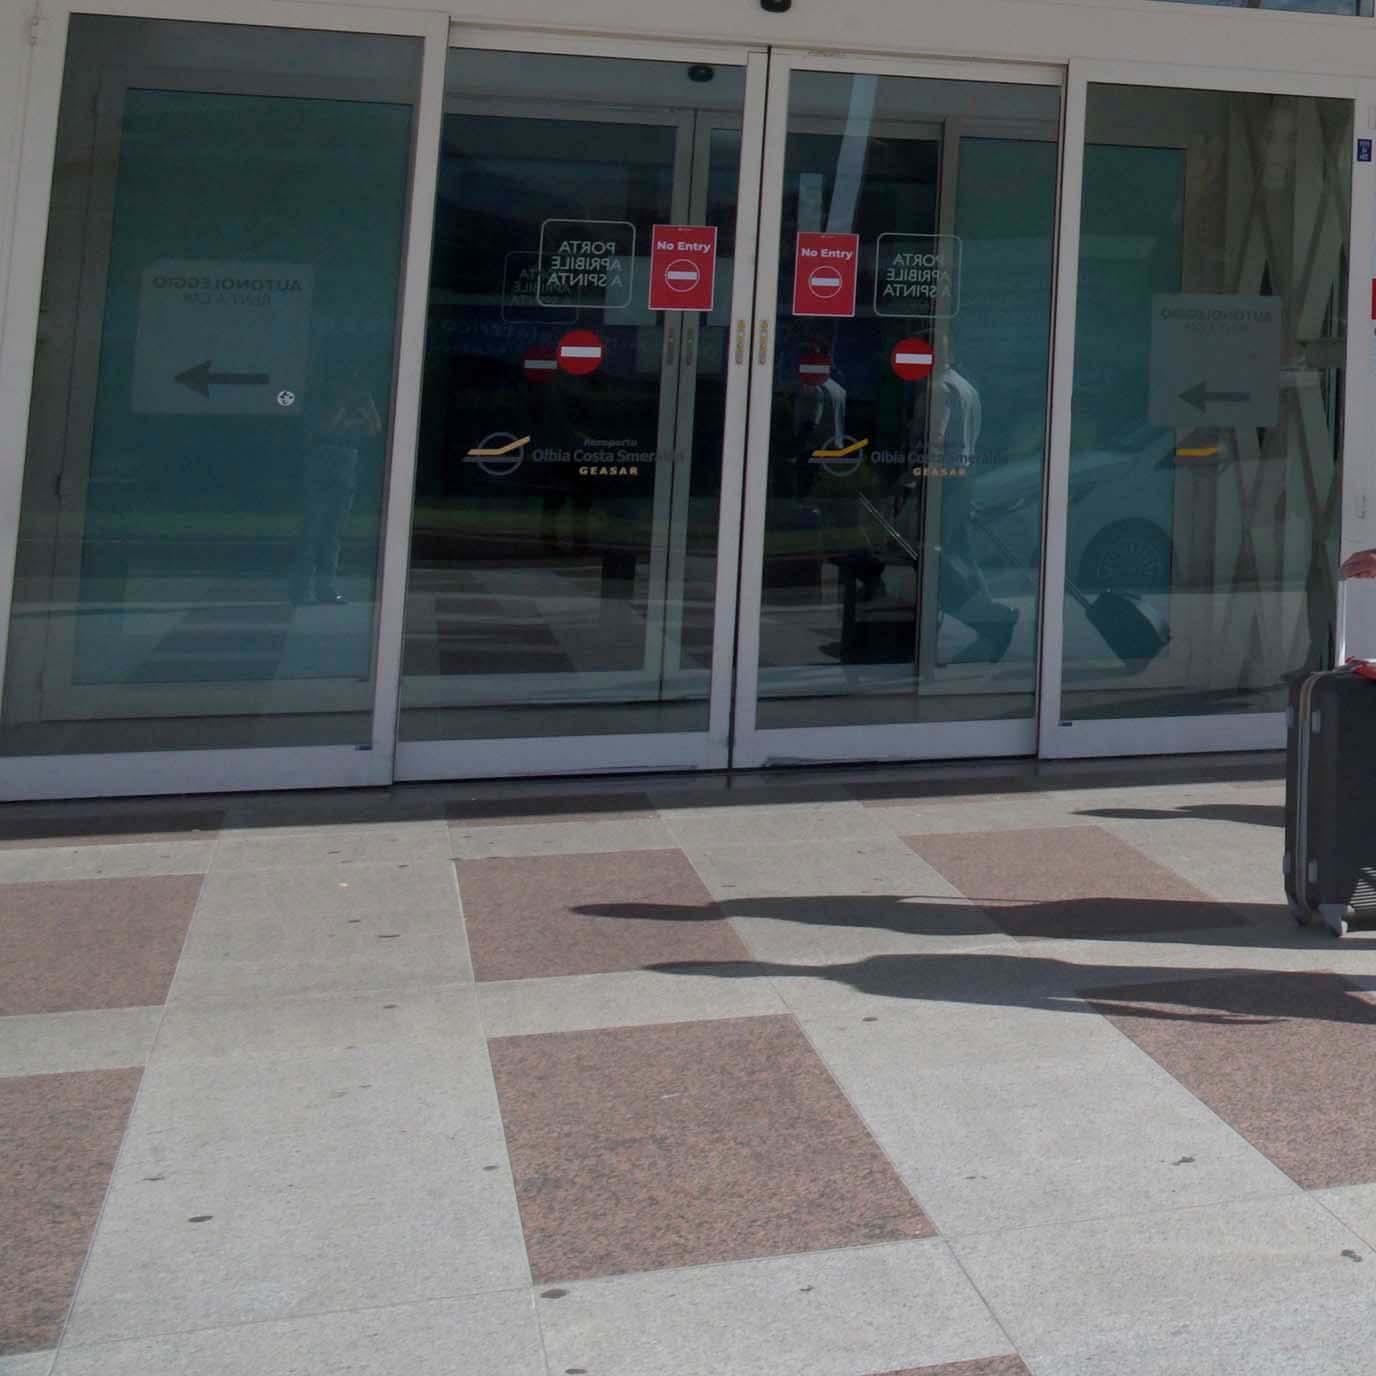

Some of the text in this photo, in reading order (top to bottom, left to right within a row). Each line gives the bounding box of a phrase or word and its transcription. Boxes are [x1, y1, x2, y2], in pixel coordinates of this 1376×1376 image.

[656, 240, 711, 254] No Entry
[801, 247, 853, 261] No Entry
[532, 448, 685, 463] Olbia Costa Smer
[870, 450, 906, 464] Olbia
[579, 466, 638, 476] GEASAR
